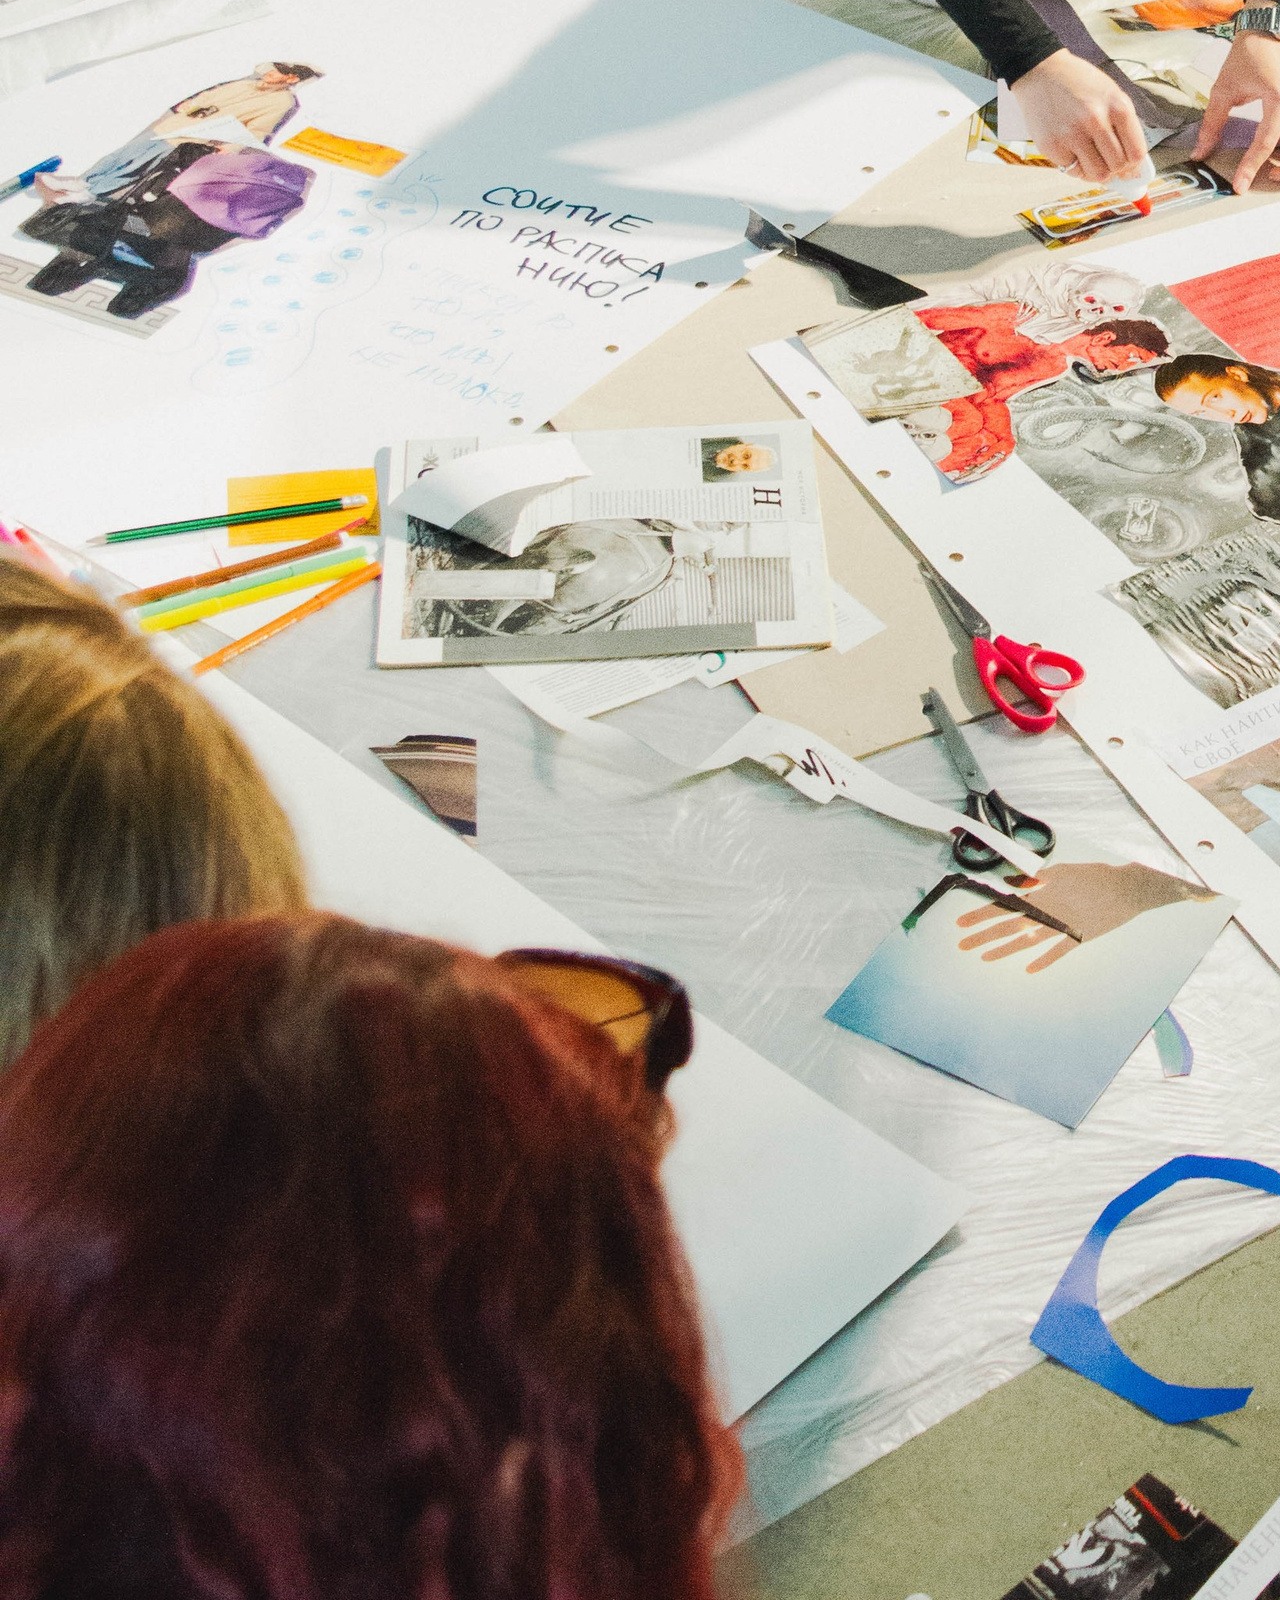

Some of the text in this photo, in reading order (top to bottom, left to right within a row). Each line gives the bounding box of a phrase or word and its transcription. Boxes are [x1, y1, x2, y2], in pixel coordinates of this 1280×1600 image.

[450, 210, 504, 232] ПО
[516, 257, 650, 308] НИЮ!
[753, 486, 782, 507] Н
[1180, 732, 1219, 757] КАК
[1193, 739, 1246, 770] СВОЁ
